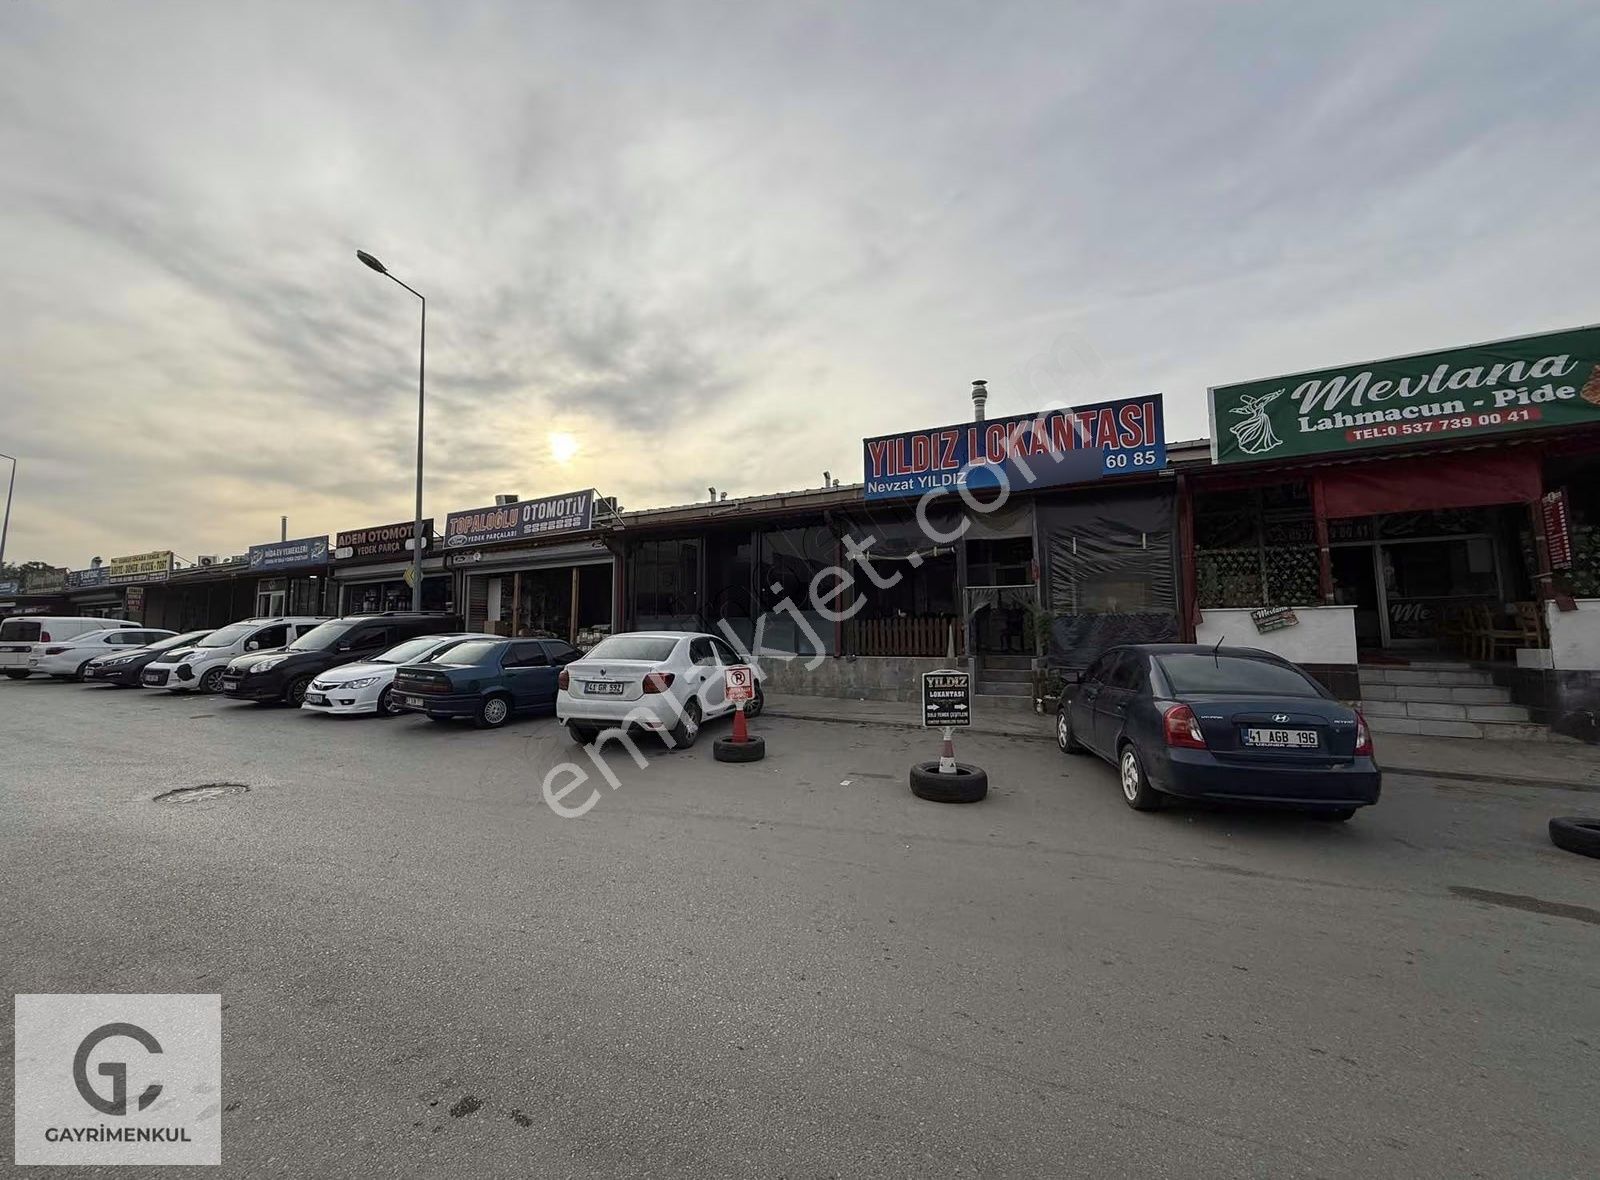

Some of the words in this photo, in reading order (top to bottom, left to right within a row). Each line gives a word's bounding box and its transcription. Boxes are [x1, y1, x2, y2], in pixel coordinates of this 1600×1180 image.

[1290, 353, 1578, 414] Mevlana
[1298, 399, 1465, 432] Lahmacun
[1492, 384, 1577, 408] Pide
[1402, 422, 1433, 435] 537
[1439, 417, 1472, 430] 739
[1478, 413, 1501, 425] 00
[1507, 409, 1530, 422] 41
[867, 430, 960, 478] YILDIZ
[968, 402, 1156, 467] LOKANTASI
[1106, 454, 1126, 469] 60
[1133, 451, 1156, 466] 85
[868, 479, 913, 493] Nevzat
[917, 472, 967, 488] YILDIZ
[449, 508, 519, 535] TOPALOĞLU
[338, 532, 367, 546] ADEM
[368, 525, 414, 542] OTOMOT
[357, 546, 377, 555] YEDEK
[379, 542, 400, 553] PARÇA
[926, 676, 968, 688] YILDIZ
[1249, 729, 1261, 742] 41
[1269, 731, 1289, 743] AGB
[1297, 732, 1316, 744] 196
